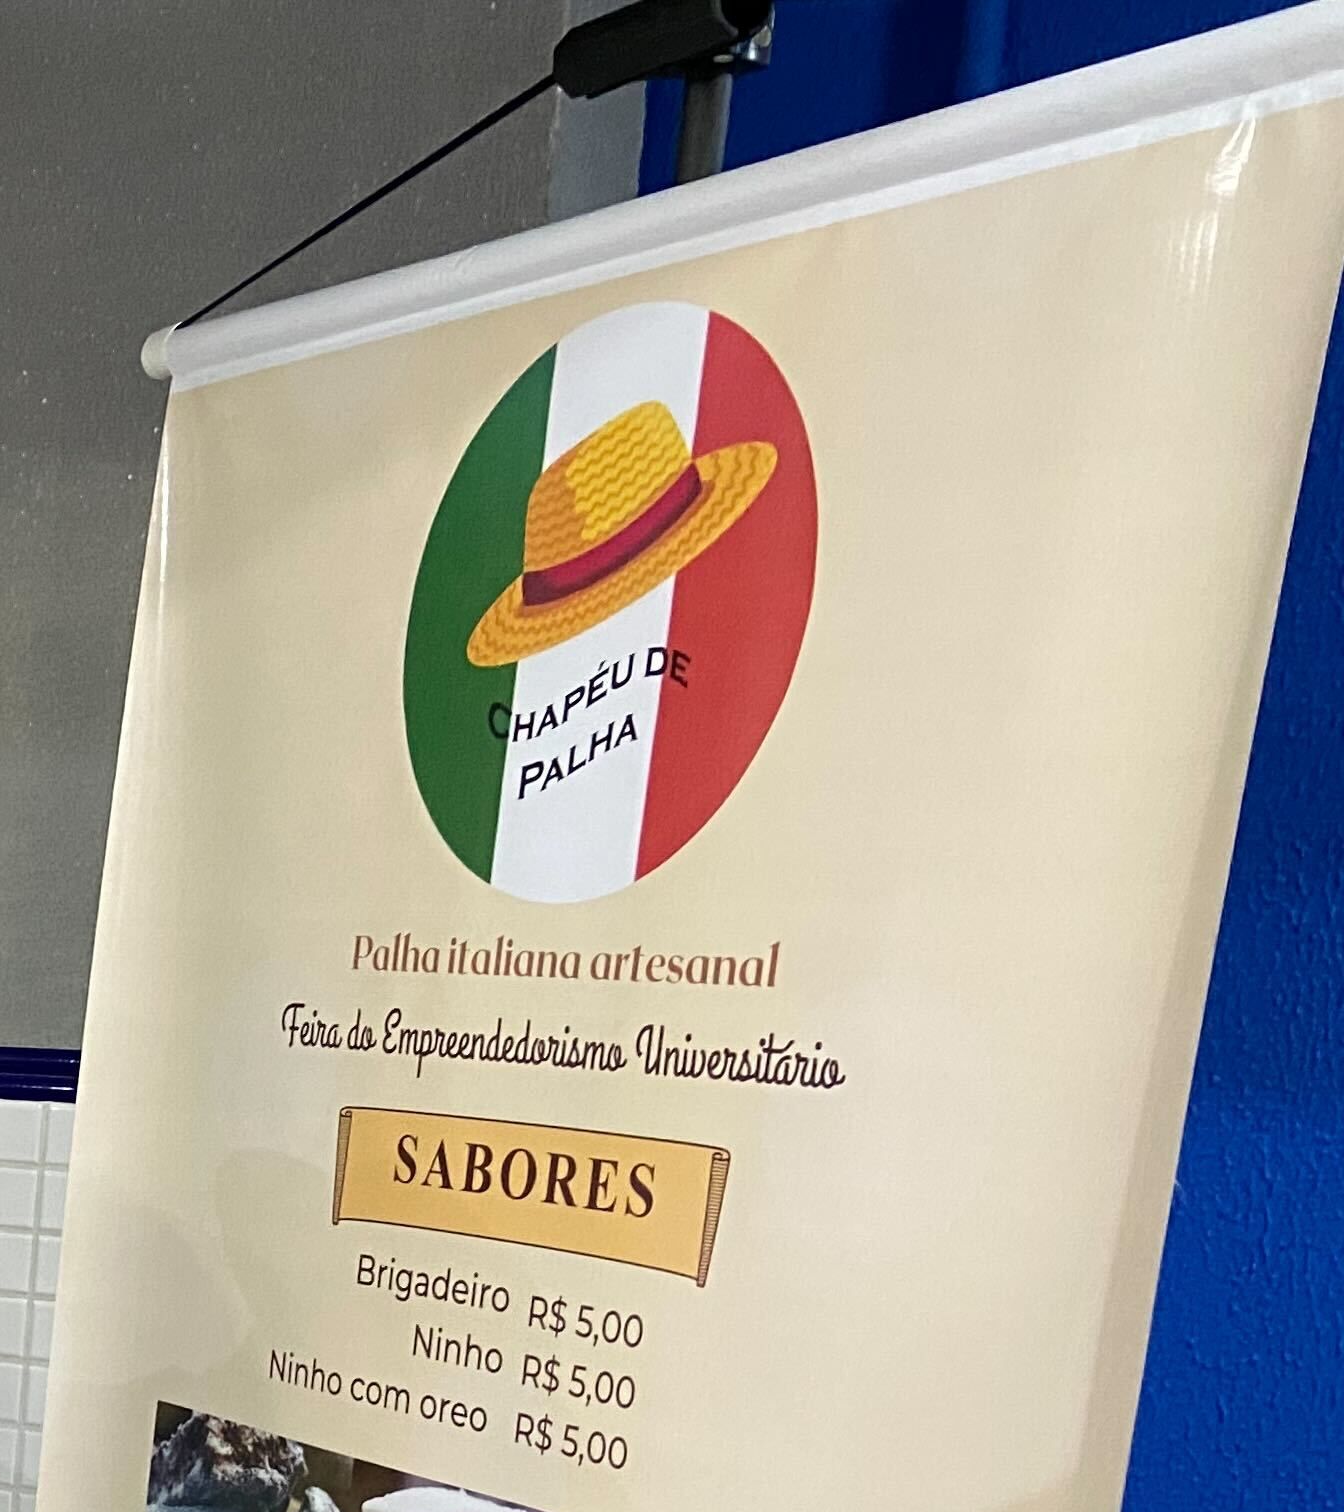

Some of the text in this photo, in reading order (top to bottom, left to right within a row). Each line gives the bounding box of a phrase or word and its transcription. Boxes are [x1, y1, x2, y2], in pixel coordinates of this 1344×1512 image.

[487, 645, 691, 743] CHAPÉU DE
[517, 713, 638, 800] PALHA
[351, 932, 781, 987] Palha italiana artesanal
[280, 1001, 846, 1089] Feira do Empreendedorismo Universitário
[392, 1134, 656, 1219] SABORES
[356, 1255, 644, 1348] Brigadeiro R$ 5,00
[269, 1349, 629, 1470] Ninho com oreo R$ 5,00
[413, 1324, 636, 1409] Ninho R$ 5,00
